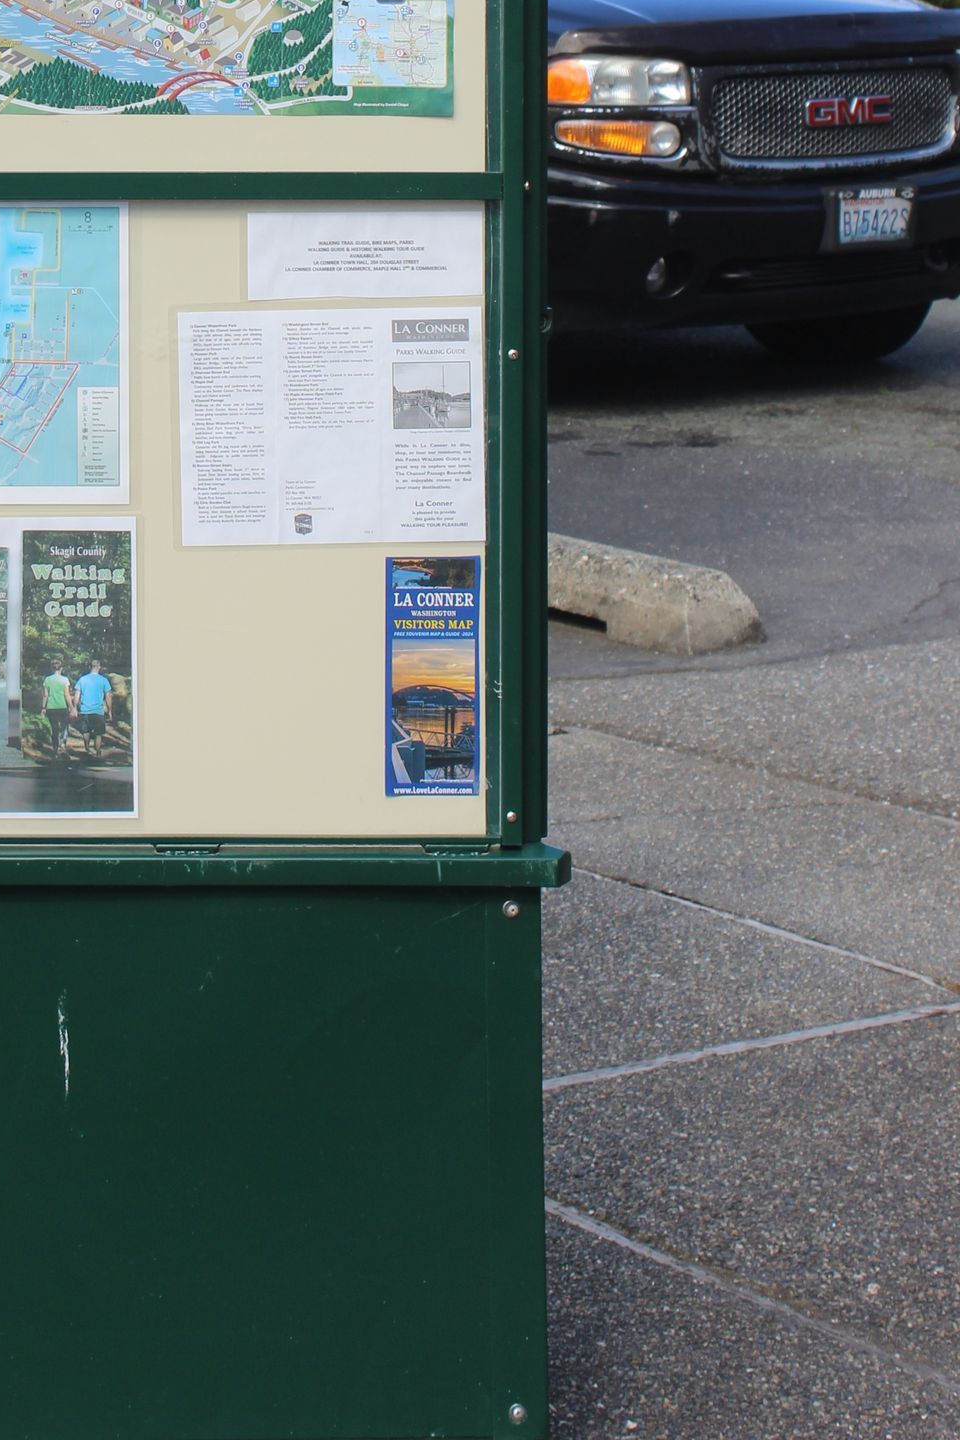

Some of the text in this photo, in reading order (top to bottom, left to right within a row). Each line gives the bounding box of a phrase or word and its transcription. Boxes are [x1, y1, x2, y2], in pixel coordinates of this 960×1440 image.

[806, 95, 893, 127] GMC
[859, 188, 897, 198] AUBURN
[394, 322, 466, 334] LA CONNER
[50, 545, 107, 559] Skagit County
[31, 564, 125, 584] Walking
[49, 583, 107, 599] Trail
[394, 593, 474, 607] LA CONNER
[44, 601, 113, 617] Guide
[394, 620, 474, 629] VISITORS MAP
[393, 786, 472, 794] www.LoveLaConner.com
